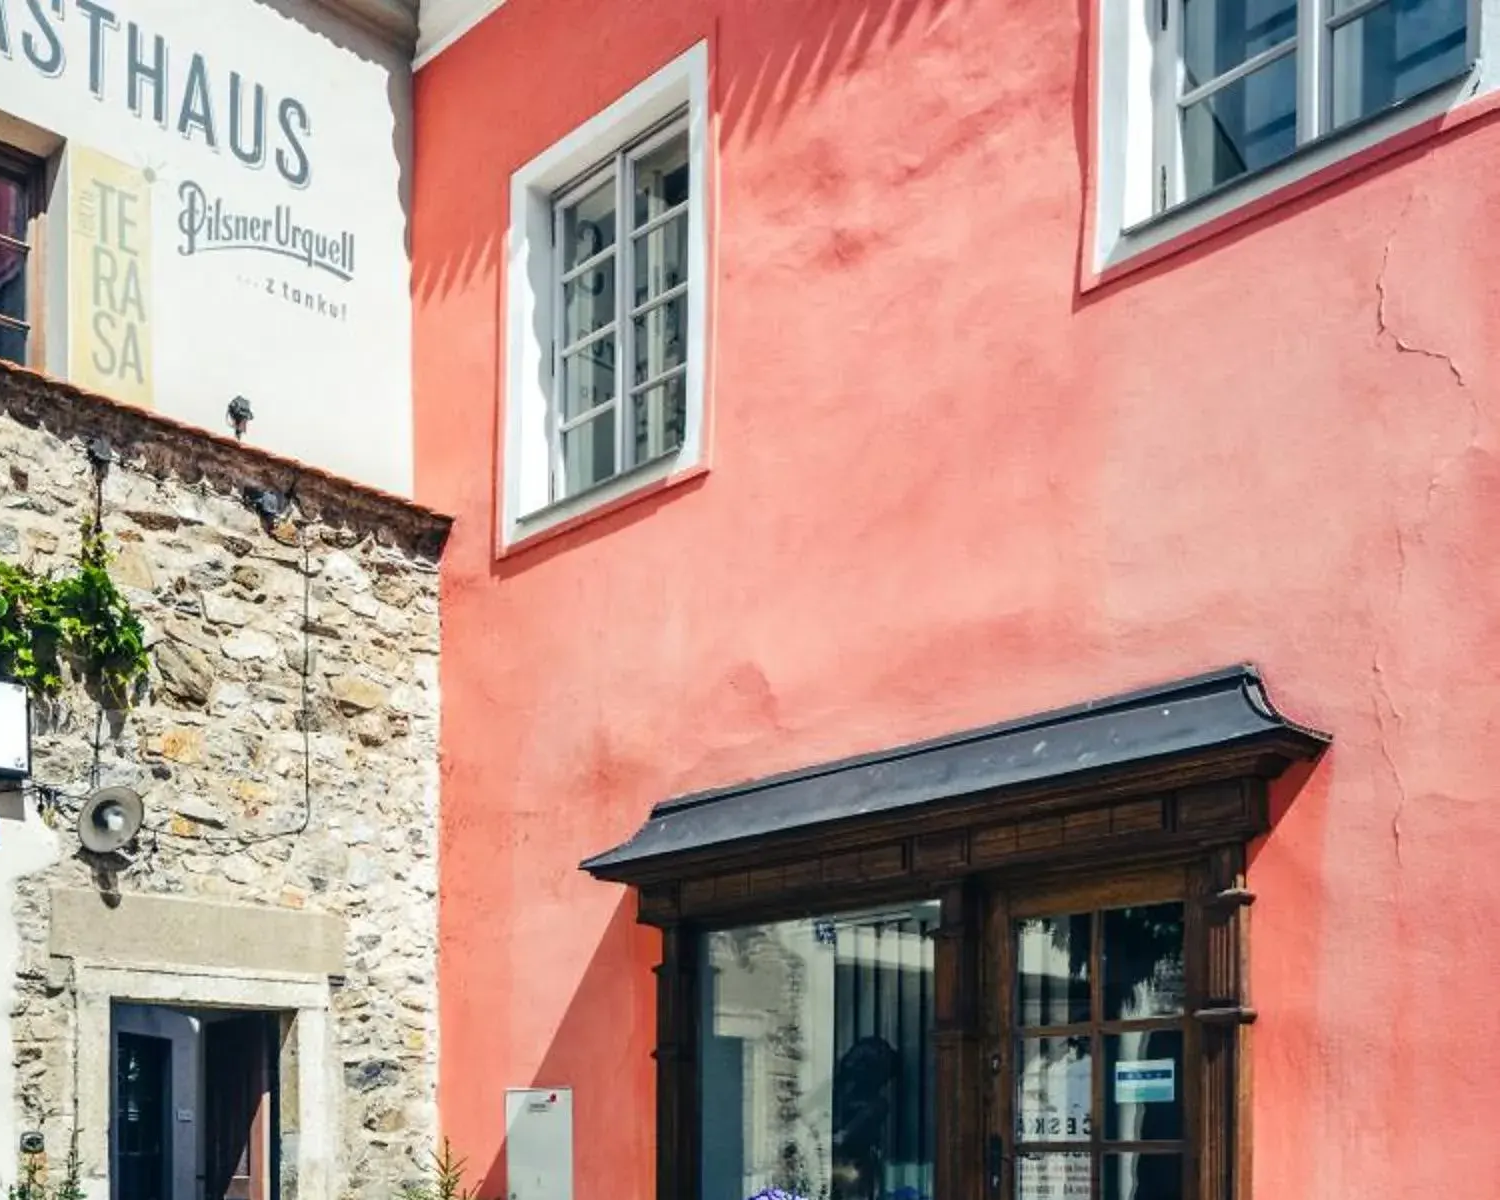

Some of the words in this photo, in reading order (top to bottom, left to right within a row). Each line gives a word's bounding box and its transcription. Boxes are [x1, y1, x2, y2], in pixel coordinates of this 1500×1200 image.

[178, 180, 273, 256] Pilsner
[275, 205, 354, 272] Urquell
[282, 281, 348, 321] tanku!
